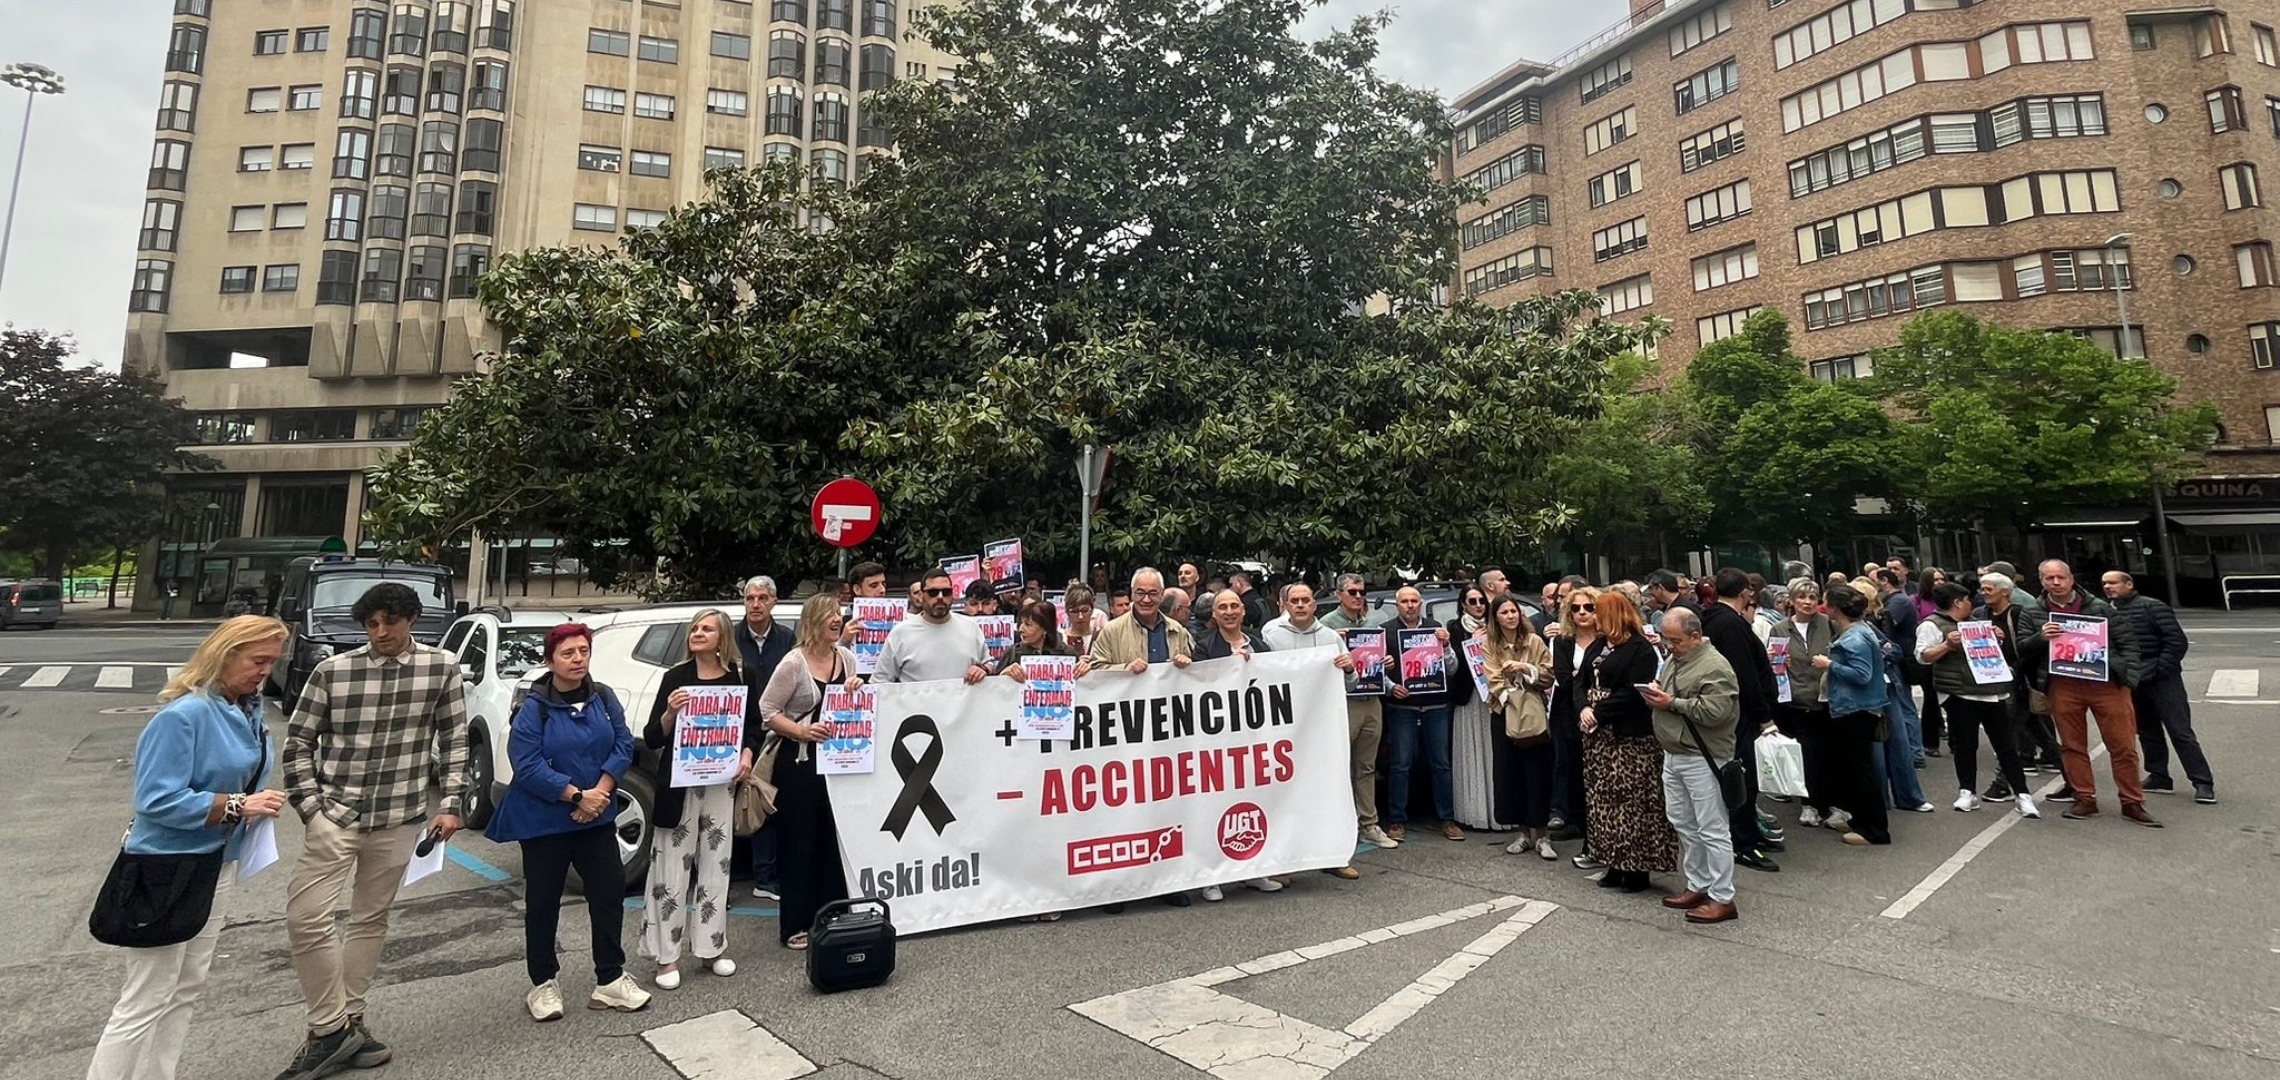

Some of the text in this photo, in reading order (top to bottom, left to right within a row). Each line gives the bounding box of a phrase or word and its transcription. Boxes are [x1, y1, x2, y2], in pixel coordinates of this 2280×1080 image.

[858, 605, 904, 622] TRABAJAR
[979, 622, 1012, 640] ABAJAR
[1025, 663, 1072, 681] TRABAJAR
[1405, 660, 1422, 679] 28
[685, 696, 743, 717] TRABAJAR
[828, 693, 874, 711] TRABAJAR
[1023, 689, 1072, 708] ENFERMAR
[1023, 704, 1071, 718] NO
[1040, 678, 1294, 754] REVENCIÓN
[680, 725, 740, 749] ENFERMAR
[822, 736, 869, 751] NO
[680, 744, 736, 761] NO
[1040, 739, 1295, 816] ACCIDENTES
[1223, 809, 1261, 838] UGT
[1073, 838, 1151, 869] CCOO
[860, 851, 980, 901] Aski da!
